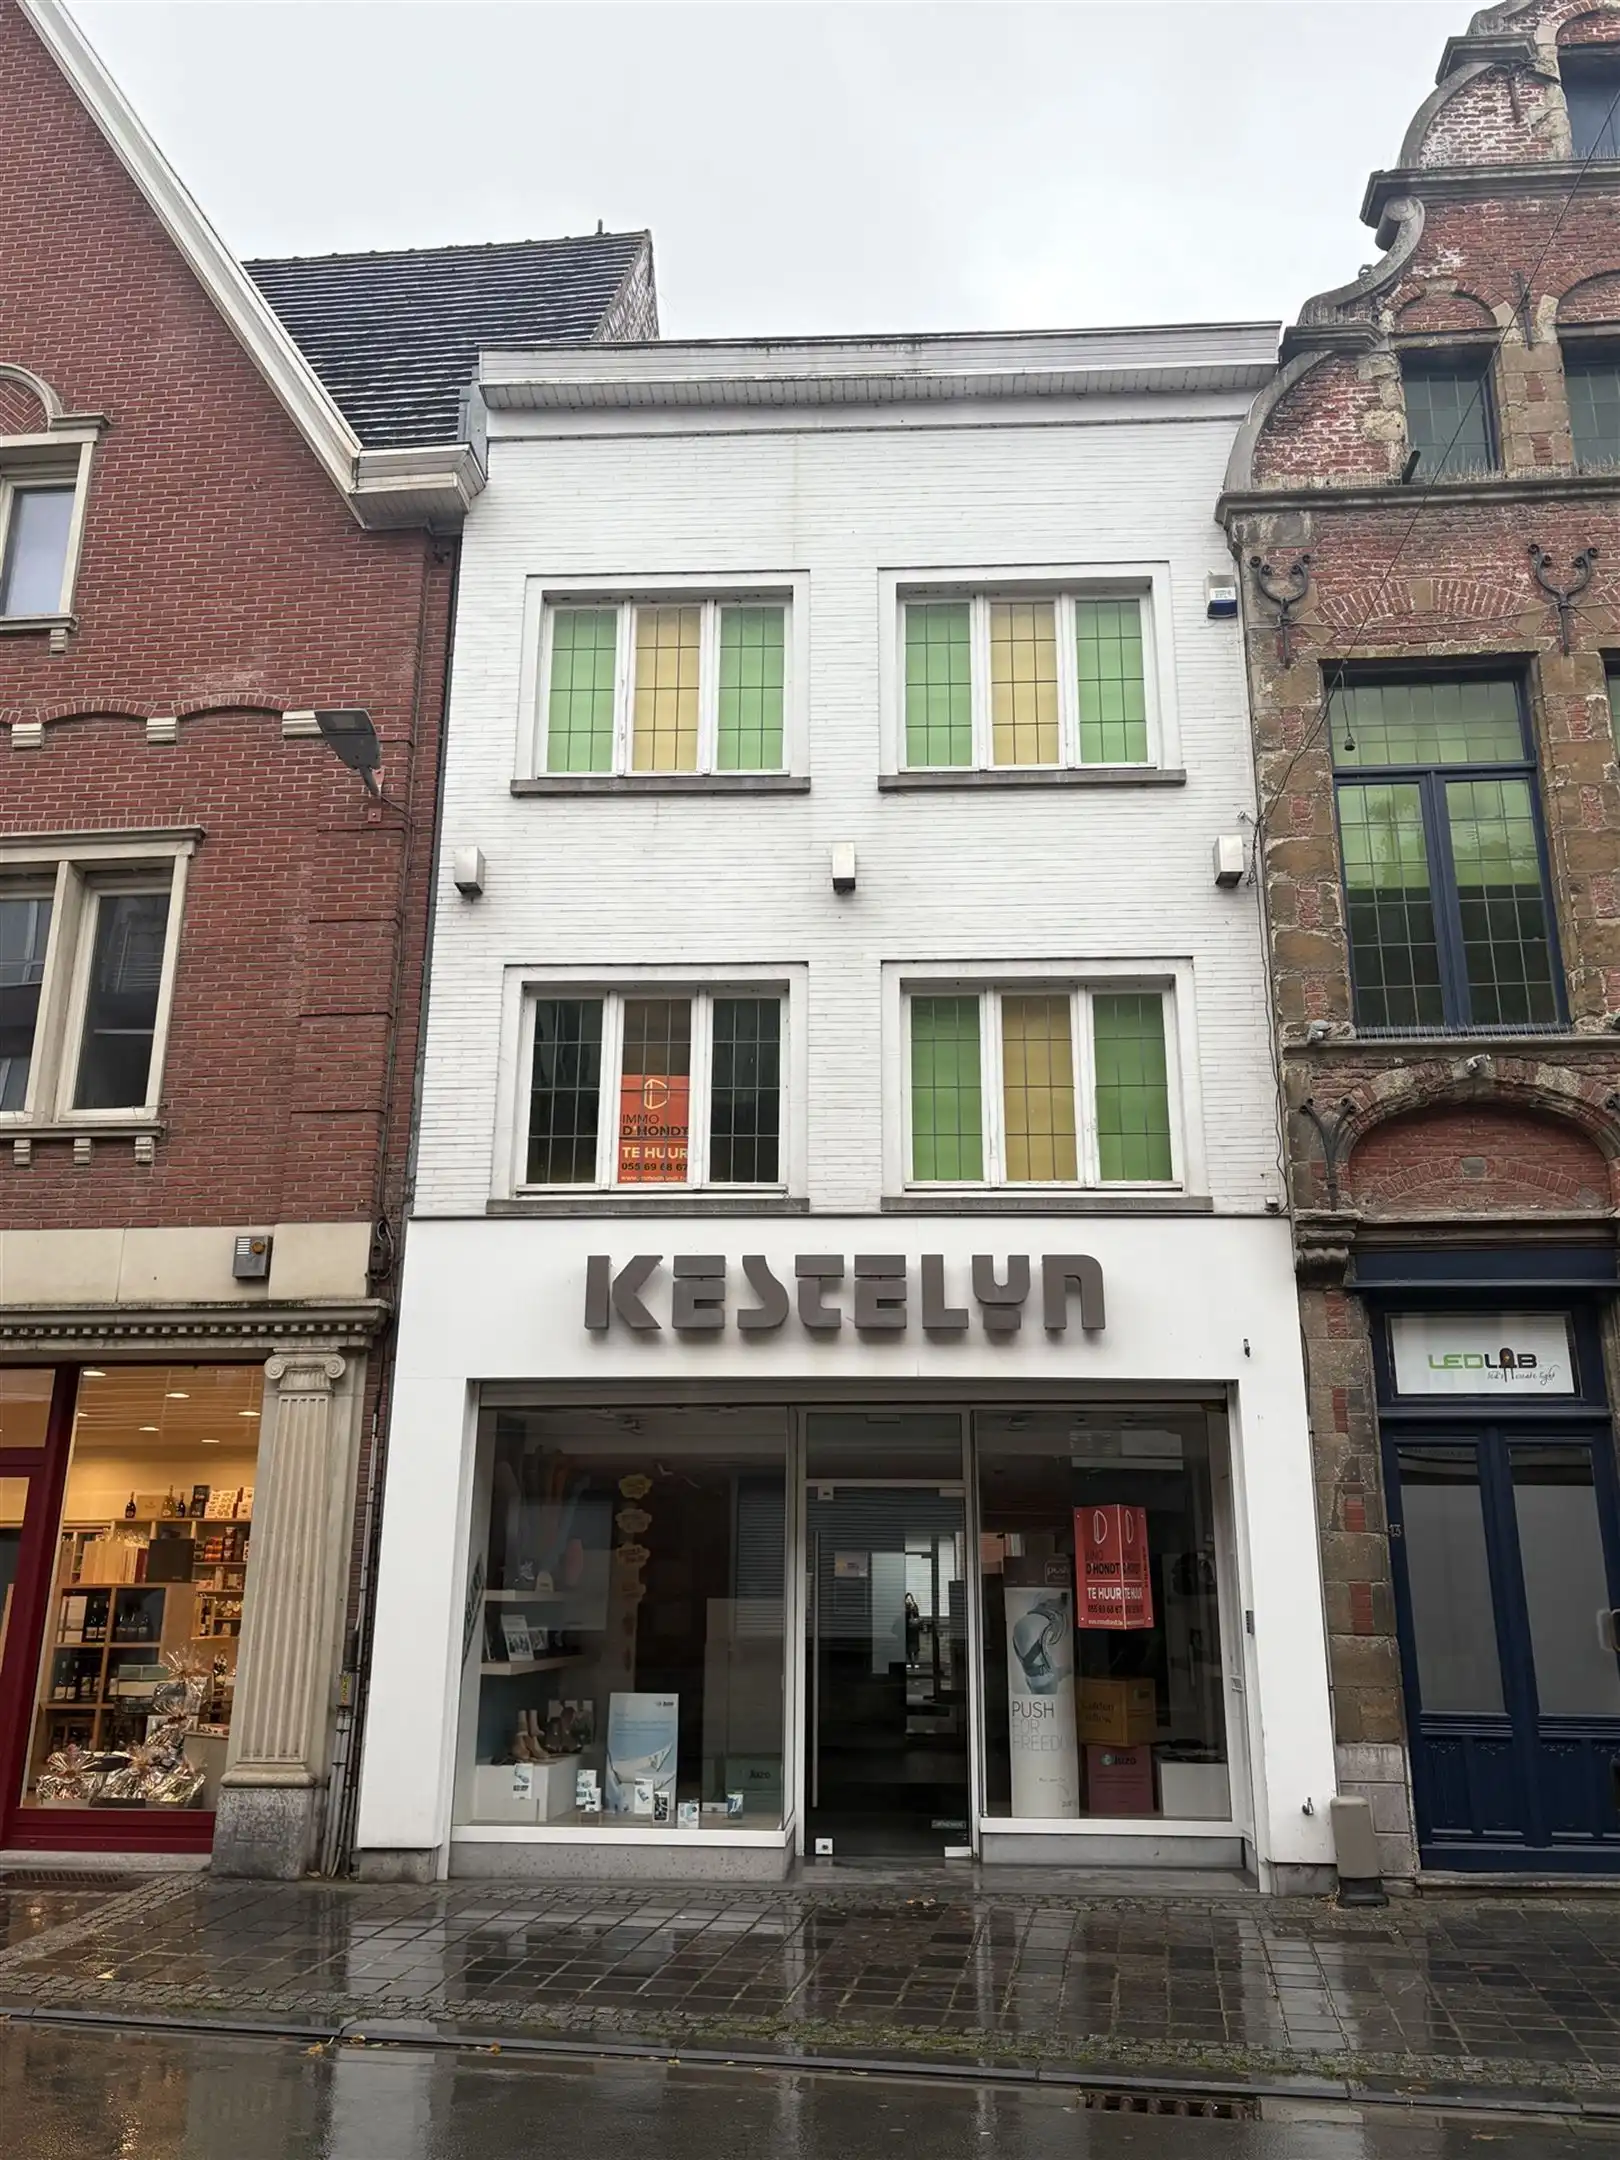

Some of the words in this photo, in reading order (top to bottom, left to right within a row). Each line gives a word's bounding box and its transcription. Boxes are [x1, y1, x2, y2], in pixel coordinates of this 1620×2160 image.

[622, 1114, 660, 1124] IMMO
[622, 1147, 640, 1159] TE
[644, 1147, 688, 1159] HUUR
[621, 1162, 640, 1171] 055
[644, 1162, 657, 1171] 69
[584, 1254, 1106, 1330] KESTELYN
[1087, 1587, 1096, 1600] TE
[1098, 1587, 1121, 1600] HUUR
[1012, 1701, 1054, 1718] PUSH
[1012, 1718, 1040, 1735] FOR
